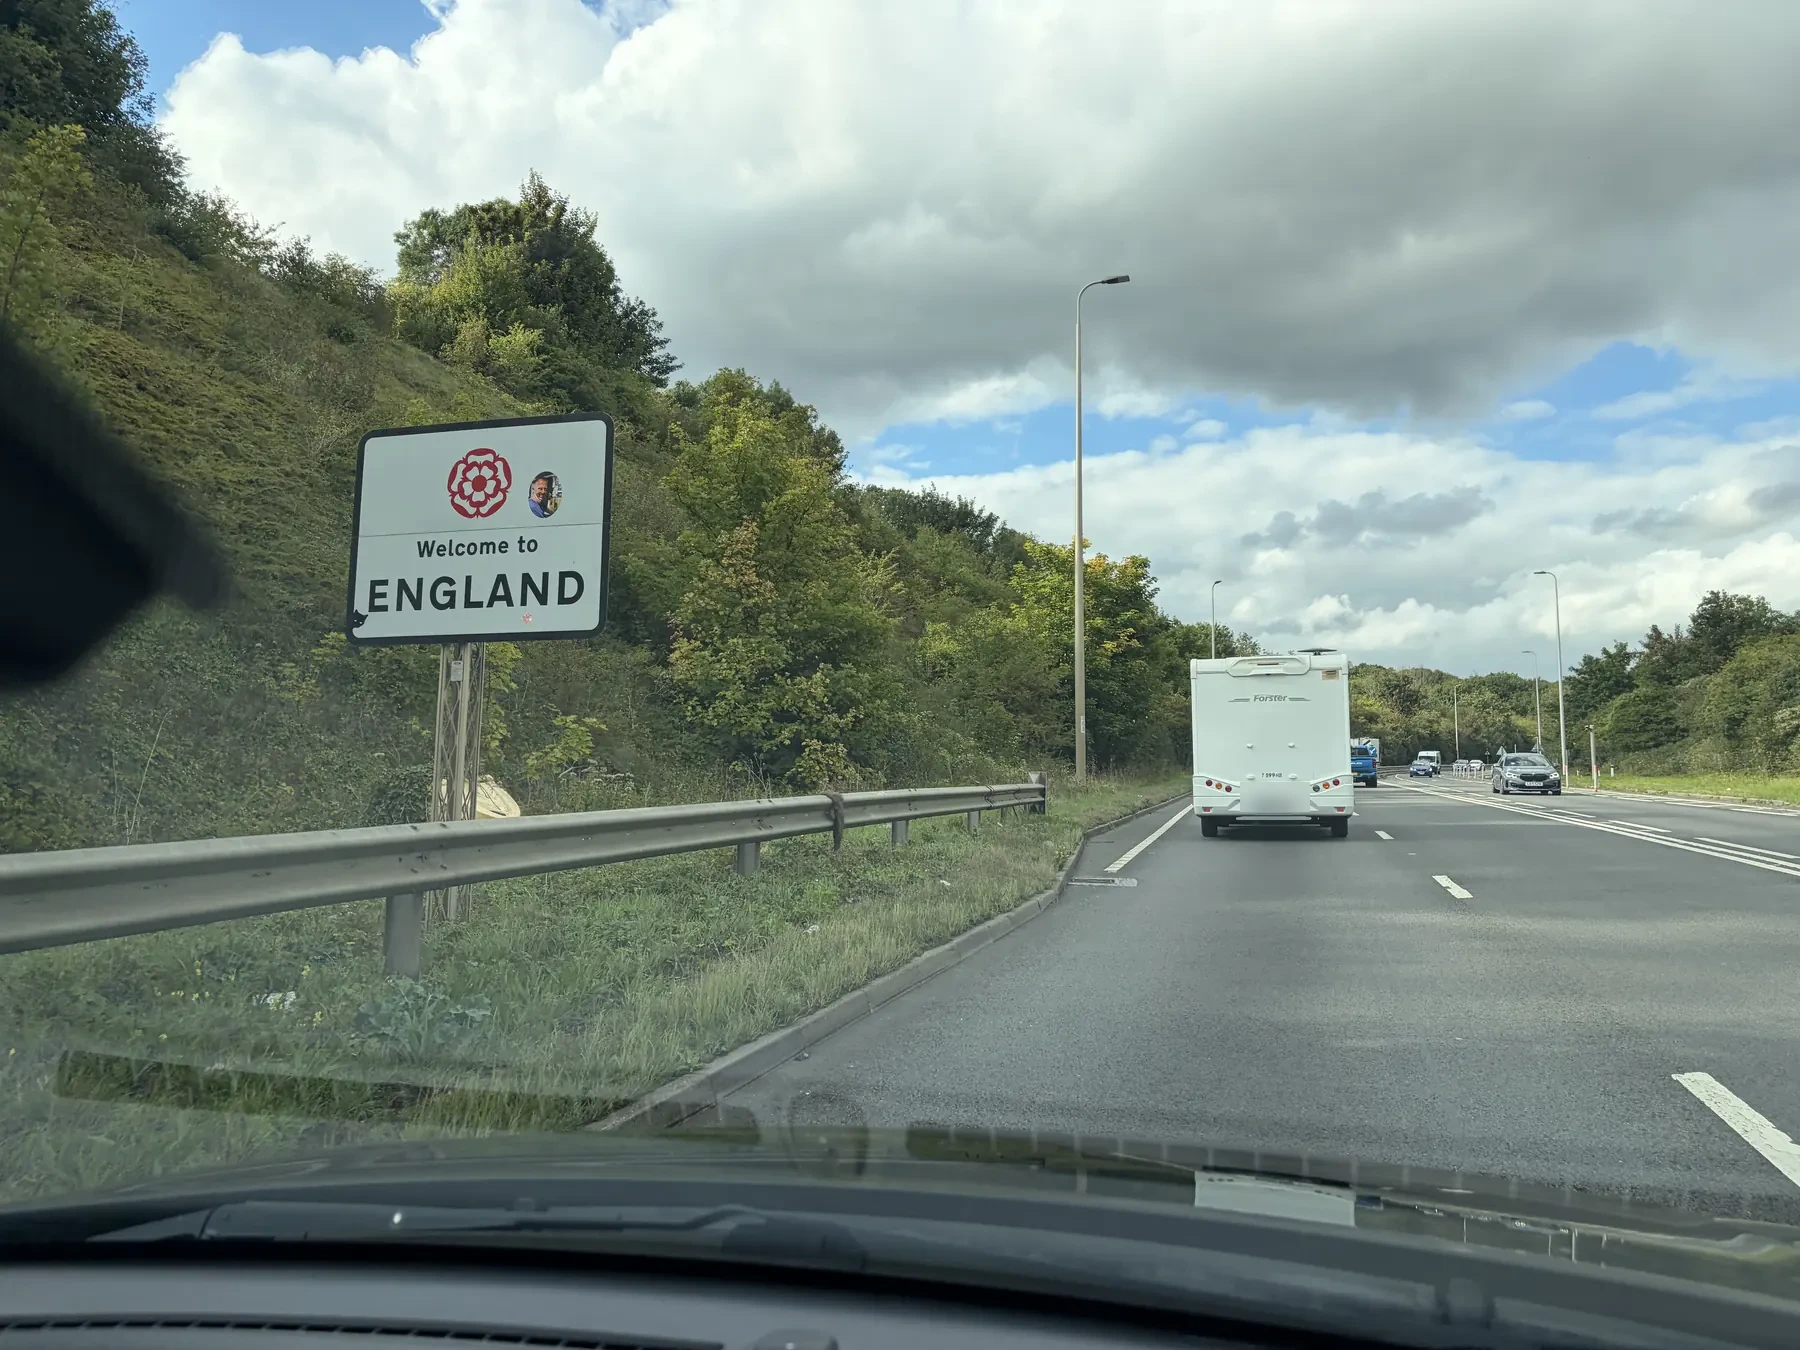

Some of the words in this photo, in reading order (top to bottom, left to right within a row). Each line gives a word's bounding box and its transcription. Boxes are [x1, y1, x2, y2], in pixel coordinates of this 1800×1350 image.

[417, 539, 509, 557] Welcome
[517, 536, 538, 553] to
[368, 571, 585, 613] ENGLAND
[1253, 694, 1288, 702] Forster
